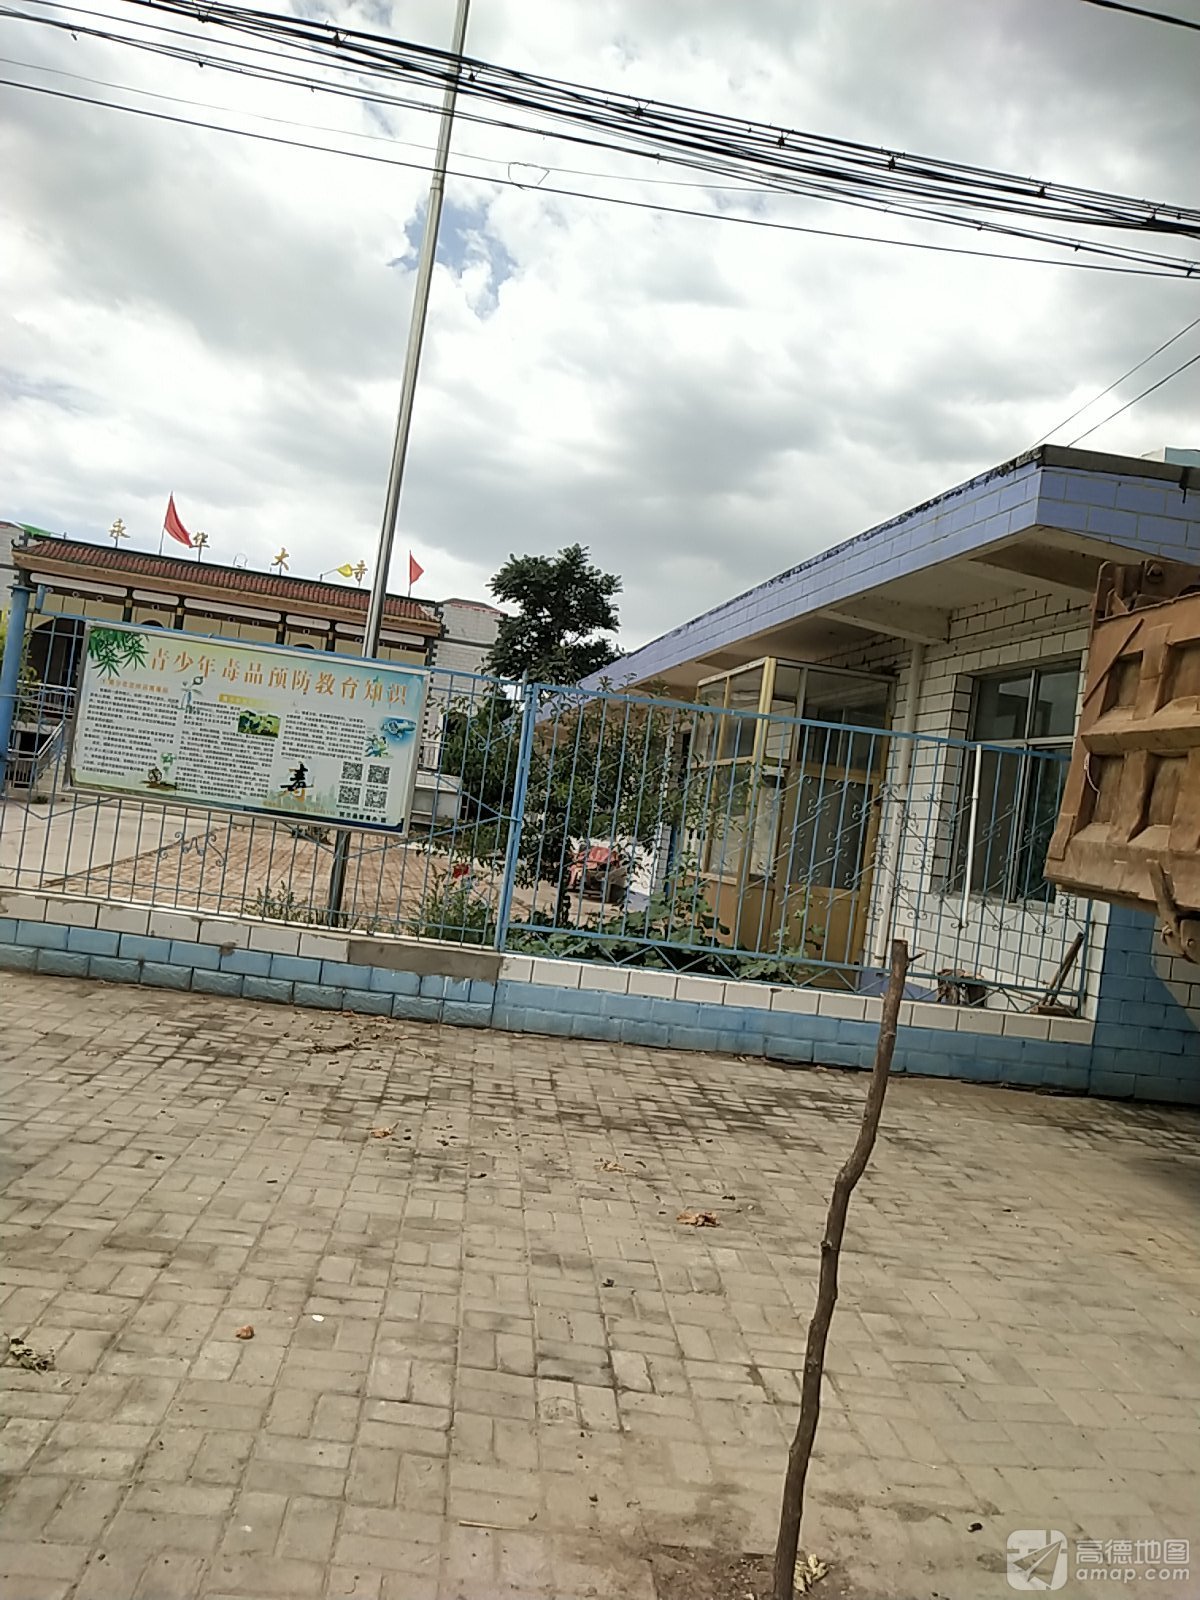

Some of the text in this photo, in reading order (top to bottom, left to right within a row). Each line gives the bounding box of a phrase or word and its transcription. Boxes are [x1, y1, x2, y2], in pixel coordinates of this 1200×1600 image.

[149, 647, 409, 707] 青少年毒品预防教育知识
